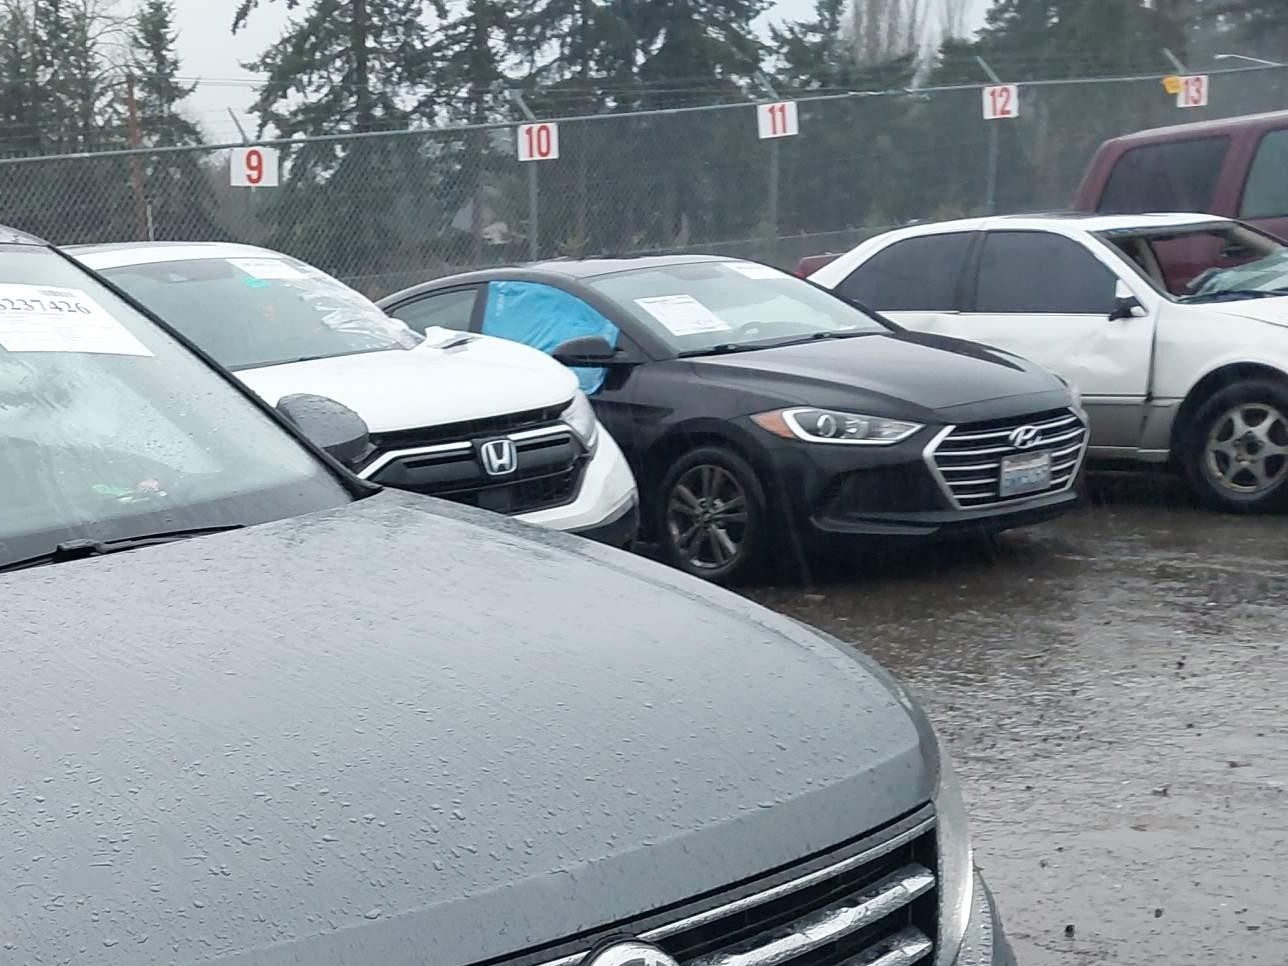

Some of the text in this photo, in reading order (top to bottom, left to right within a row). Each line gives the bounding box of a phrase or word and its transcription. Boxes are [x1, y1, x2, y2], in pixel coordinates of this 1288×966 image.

[990, 87, 1011, 116] 12
[1184, 77, 1202, 105] 13
[768, 104, 786, 135] 11
[526, 125, 550, 158] 10
[246, 150, 262, 184] 9
